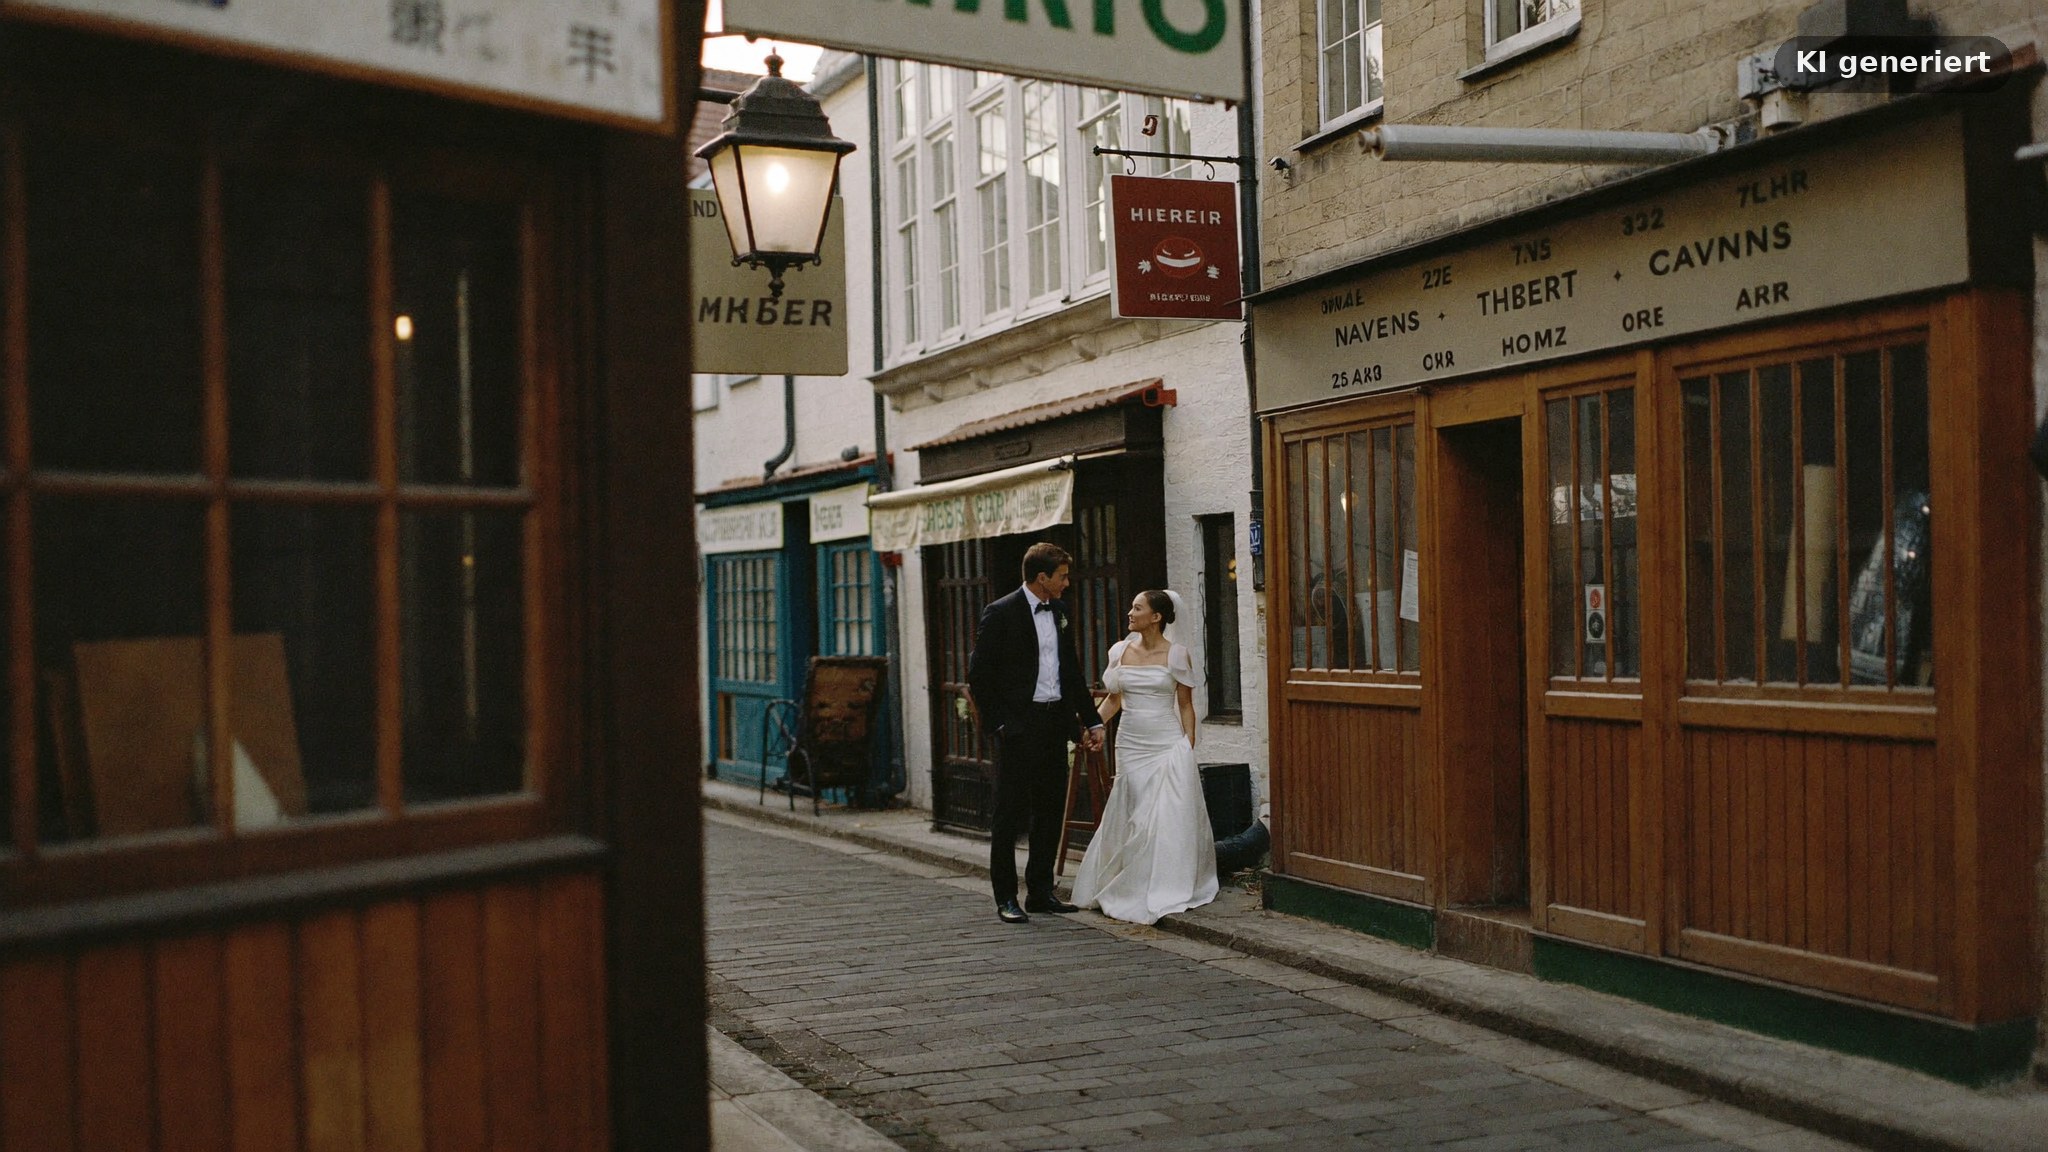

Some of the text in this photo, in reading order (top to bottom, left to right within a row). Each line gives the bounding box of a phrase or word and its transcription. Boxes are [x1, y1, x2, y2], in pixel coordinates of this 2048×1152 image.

[690, 199, 718, 217] ND
[1130, 207, 1222, 225] HIEREIR
[1335, 221, 1791, 347] NAVENS THBERT CAVNNS
[1502, 326, 1567, 356] HOMZ
[1622, 306, 1665, 332] ORE
[1736, 281, 1790, 311] ARR
